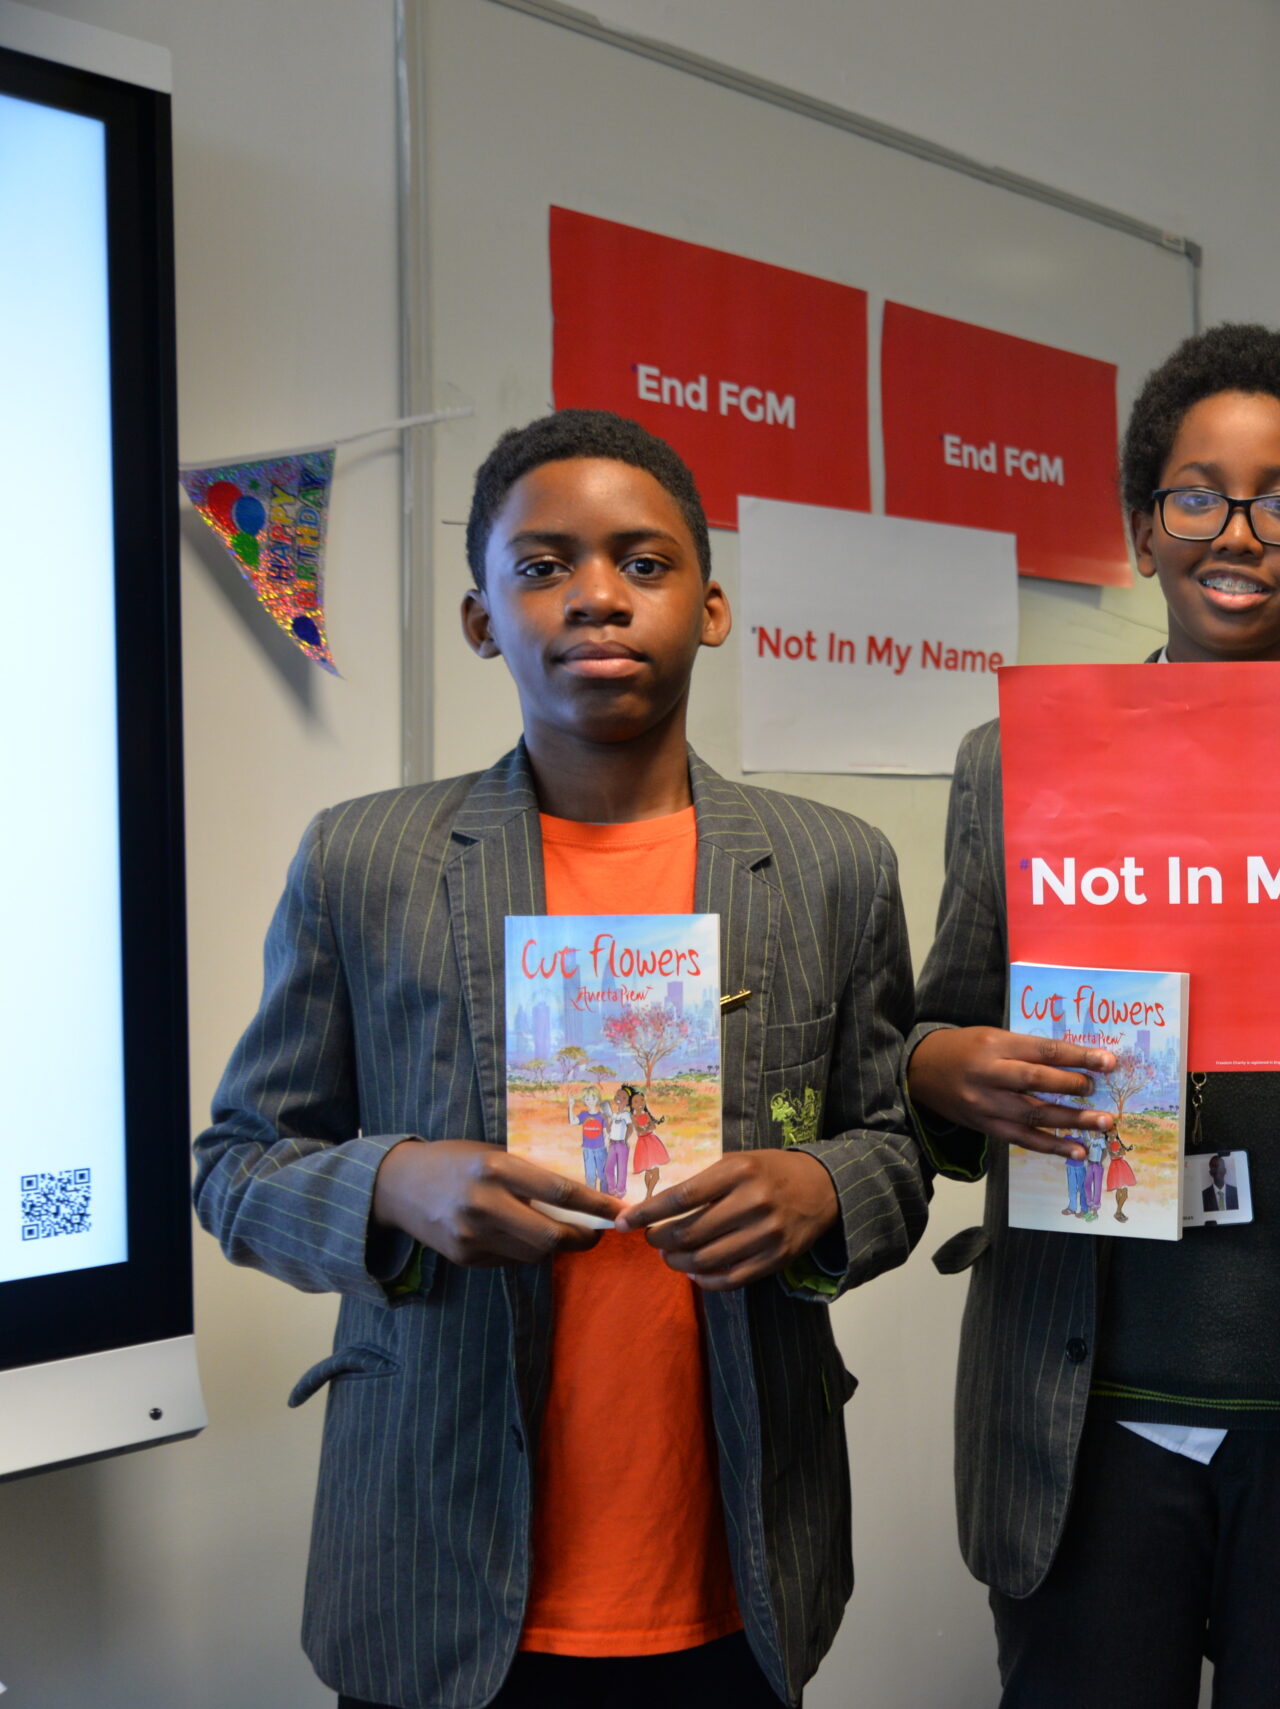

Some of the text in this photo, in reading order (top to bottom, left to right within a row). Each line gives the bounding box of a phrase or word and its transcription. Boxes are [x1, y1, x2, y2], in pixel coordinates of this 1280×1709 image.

[719, 380, 796, 430] FGM
[1004, 445, 1065, 487] FGM
[269, 484, 297, 582] HAPPY
[296, 467, 326, 608] BIRTHDAY
[828, 632, 855, 664] In
[866, 635, 913, 676] My
[921, 640, 1003, 674] Name
[1168, 856, 1223, 904] In
[522, 938, 582, 979] Cut
[1021, 985, 1067, 1022] Cut
